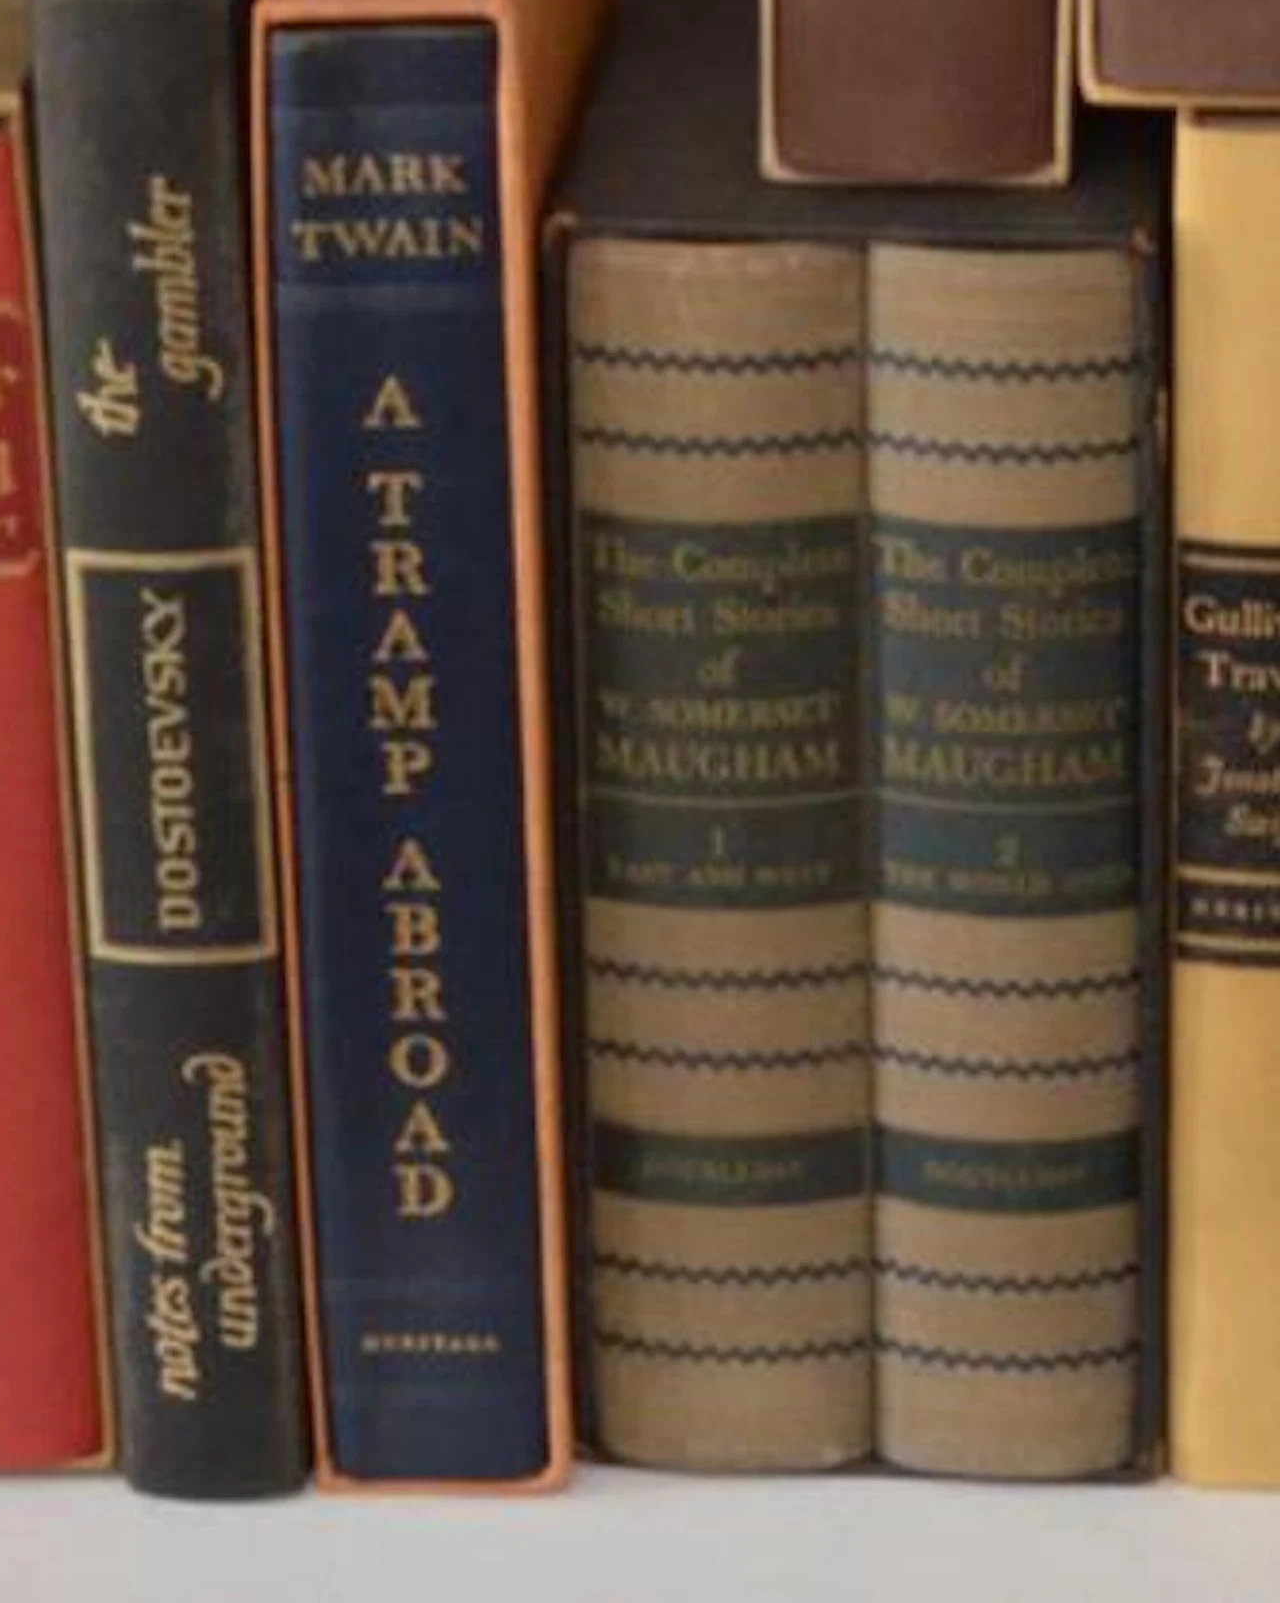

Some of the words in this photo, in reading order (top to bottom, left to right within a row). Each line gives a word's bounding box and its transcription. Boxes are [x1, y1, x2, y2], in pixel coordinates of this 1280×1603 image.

[302, 153, 467, 197] MARK
[290, 217, 484, 261] TWAIN
[126, 176, 223, 399] gambler
[77, 337, 142, 437] the
[363, 374, 422, 428] A
[872, 535, 947, 580] The
[367, 470, 438, 795] TRAMP
[697, 649, 742, 686] of
[981, 656, 1028, 692] of
[649, 691, 840, 730] SOMERSET
[934, 697, 1126, 735] SOMERSET
[141, 589, 201, 931] DOSTOEVSKY
[597, 738, 840, 781] MAUGHAM
[882, 740, 1123, 787] MAUGHAM
[381, 838, 455, 1218] ABROAD
[134, 1138, 187, 1263] from
[182, 1053, 276, 1349] underground
[146, 1275, 199, 1400] notes
